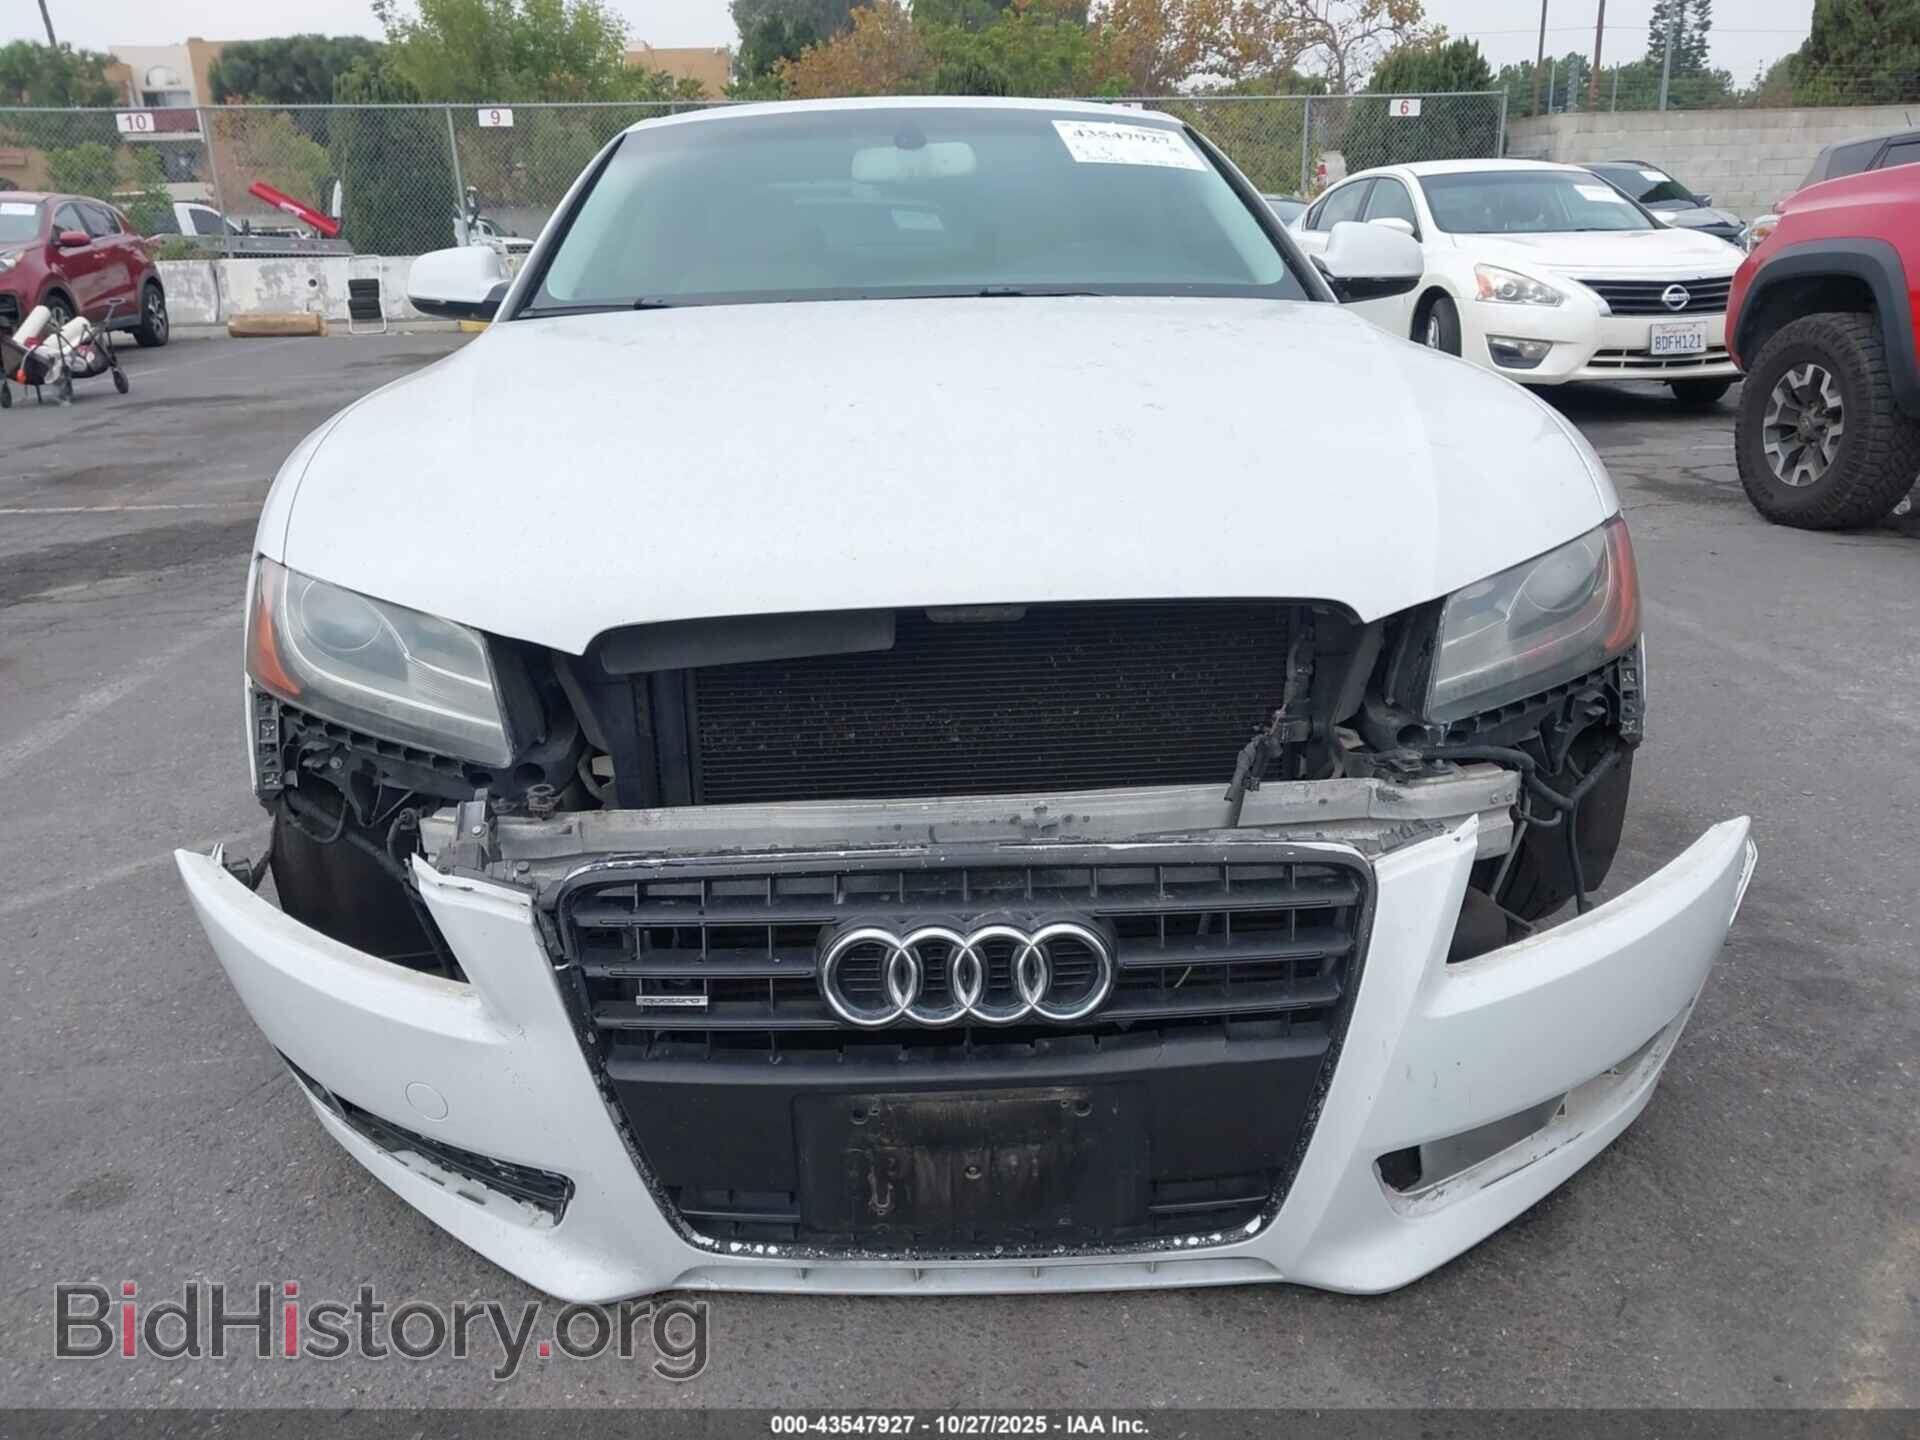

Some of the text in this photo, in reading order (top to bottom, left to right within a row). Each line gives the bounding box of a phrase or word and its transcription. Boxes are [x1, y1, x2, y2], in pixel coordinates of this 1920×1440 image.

[1400, 100, 1409, 115] 6
[126, 114, 146, 130] 10
[490, 110, 500, 125] 9
[1655, 334, 1702, 351] 8DFH121
